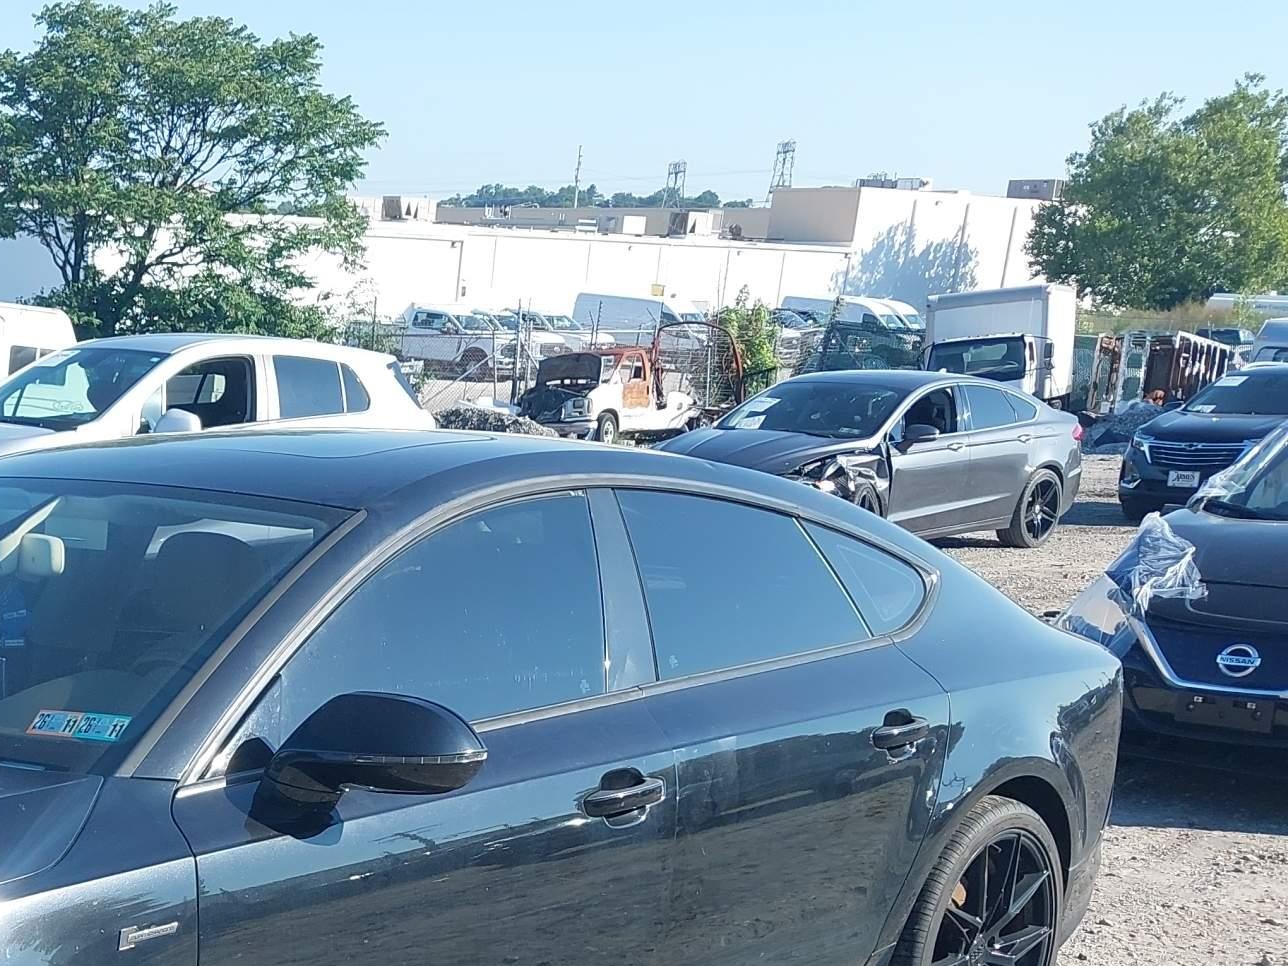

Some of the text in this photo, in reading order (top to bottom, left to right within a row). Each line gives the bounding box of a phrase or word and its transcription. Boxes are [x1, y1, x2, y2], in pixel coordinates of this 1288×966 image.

[1220, 656, 1255, 665] NISSAN
[32, 713, 79, 734] 26 11
[79, 716, 125, 738] 26 11
